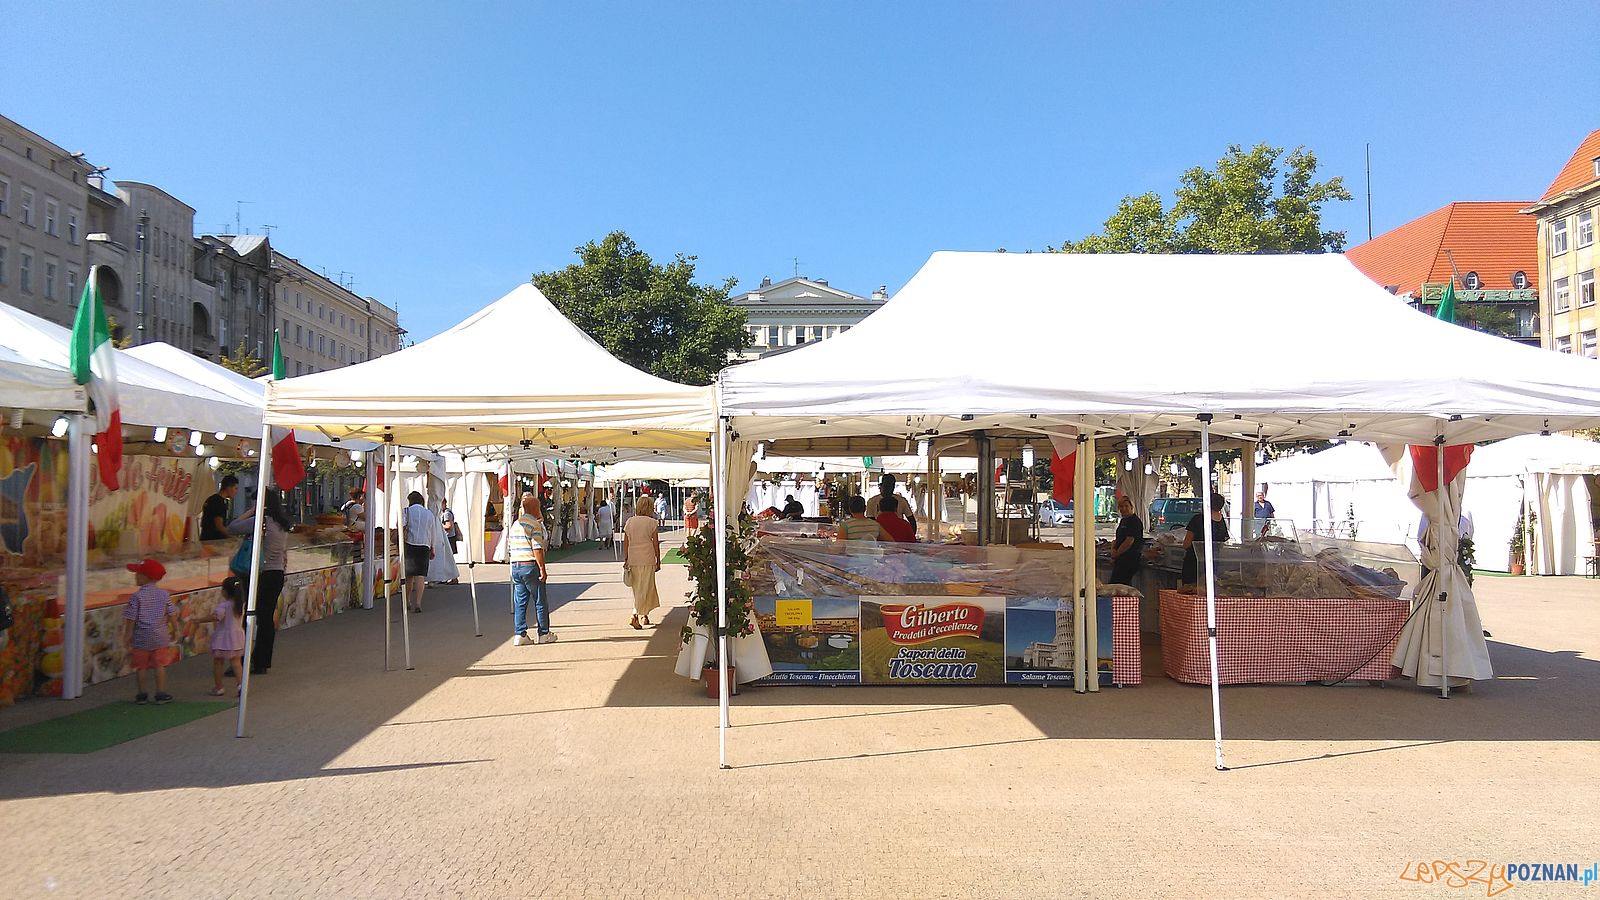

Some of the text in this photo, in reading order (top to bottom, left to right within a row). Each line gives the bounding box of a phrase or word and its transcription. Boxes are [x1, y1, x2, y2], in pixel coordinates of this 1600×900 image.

[900, 605, 969, 629] Gilberto
[893, 622, 978, 640] Prodotti d'eccellenza
[898, 647, 966, 661] Sapori della
[889, 657, 978, 679] Toscana
[1046, 673, 1072, 681] Toscano
